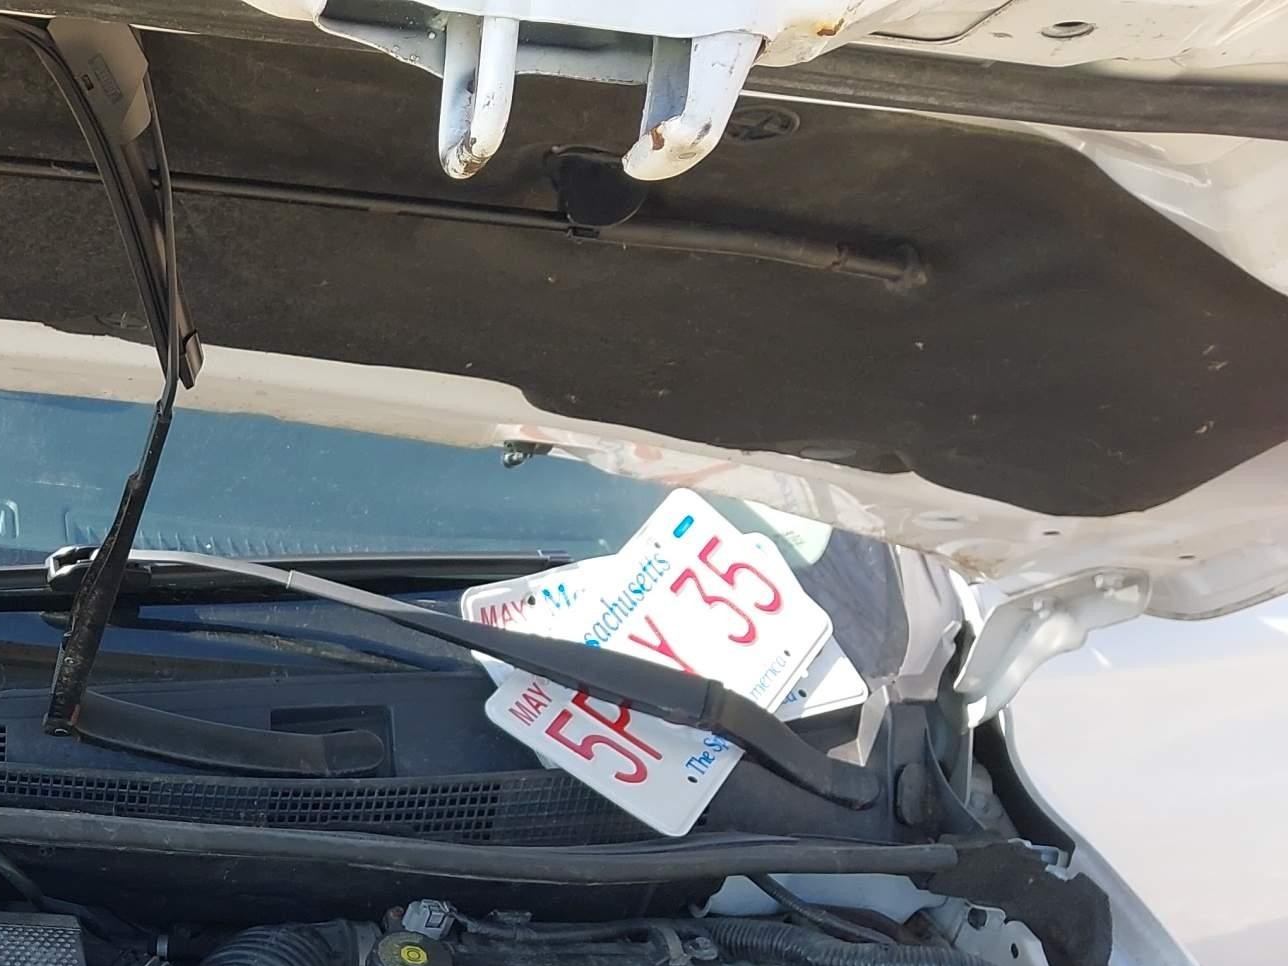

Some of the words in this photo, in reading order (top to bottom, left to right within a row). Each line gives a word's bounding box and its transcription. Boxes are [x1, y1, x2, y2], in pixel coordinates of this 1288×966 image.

[479, 596, 528, 626] MAY
[584, 553, 671, 649] sachusetts
[670, 535, 782, 645] 35
[508, 682, 553, 727] MAY
[685, 748, 716, 776] The
[749, 655, 787, 701] merica
